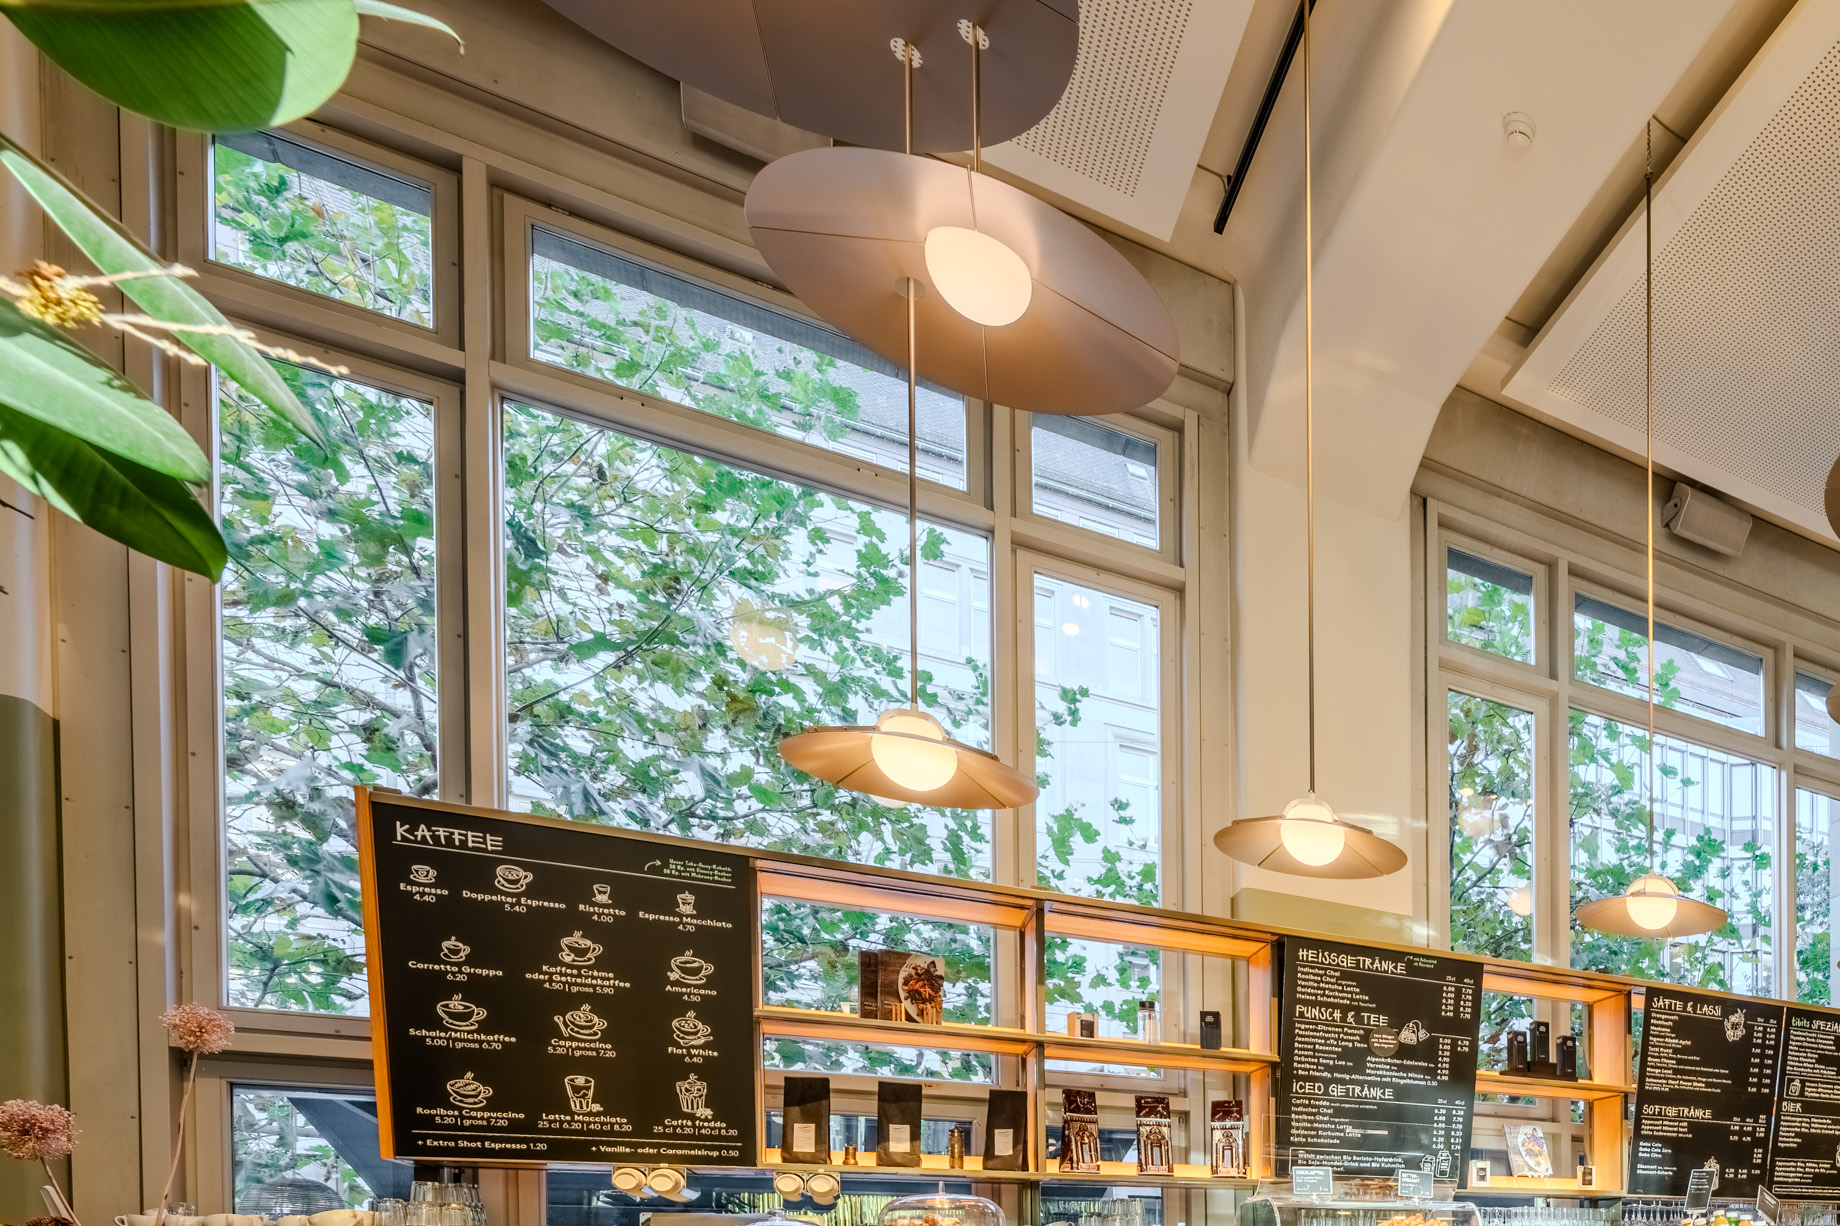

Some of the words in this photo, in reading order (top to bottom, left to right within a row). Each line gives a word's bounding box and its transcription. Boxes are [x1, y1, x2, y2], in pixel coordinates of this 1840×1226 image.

[396, 821, 504, 852] KAFFEE
[400, 883, 449, 895] Espresso
[413, 894, 436, 902] 4.40
[463, 890, 517, 903] Doppelter
[521, 897, 566, 909] Espresso
[505, 904, 526, 913] 5.40
[579, 904, 626, 916] Ristretto
[592, 914, 613, 923] 4.00
[639, 911, 680, 922] Espresso
[683, 917, 732, 928] Macchiato
[678, 924, 695, 932] 4.70
[1298, 948, 1406, 974] HEISSGETRÄNKE
[408, 961, 459, 972] Corretto
[462, 966, 503, 977] Grappa
[543, 965, 578, 975] Kaffee
[581, 969, 614, 978] Crème
[1298, 966, 1325, 974] Indischer
[447, 973, 467, 981] 6.20
[552, 974, 630, 988] Getreidekaffee
[543, 982, 563, 990] 4.50
[596, 986, 614, 994] 5.90
[665, 985, 717, 995] Americano
[1297, 980, 1342, 990] Vanille-Matcha
[1296, 986, 1324, 994] Goldener
[1325, 990, 1352, 998] Kurkuma
[1317, 995, 1350, 1004] Schokolade
[1652, 996, 1683, 1011] SÄFTE
[1686, 1002, 1694, 1014] &
[1696, 1003, 1722, 1016] LASSI
[1296, 1004, 1342, 1022] PUNSCH
[1346, 1011, 1356, 1025] &
[1360, 1012, 1388, 1026] TEE
[1792, 1016, 1810, 1027] tibits
[1295, 1022, 1342, 1032] Ingwer-Zitronen
[1344, 1027, 1364, 1035] Punsch
[1295, 1029, 1338, 1038] Passionsfrucht
[409, 1028, 516, 1042] Schale/Milchkaffee
[426, 1038, 447, 1046] 5.00
[482, 1042, 502, 1050] 6.70
[551, 1038, 612, 1050] Cappuccino
[1294, 1036, 1325, 1044] Jasmintee
[1338, 1040, 1352, 1048] Long
[1315, 1044, 1342, 1052] Rosentee
[548, 1046, 566, 1055] 5.20
[599, 1050, 616, 1058] 7.20
[668, 1047, 687, 1055] Flat
[690, 1049, 718, 1057] White
[1319, 1058, 1334, 1066] Song
[1292, 1079, 1324, 1094] ICED
[1328, 1084, 1394, 1100] GETRÄNKE
[1642, 1104, 1712, 1120] SOFTGETRÄNKE
[1782, 1101, 1802, 1112] BIER
[416, 1107, 459, 1115] Rooibos
[462, 1109, 525, 1119] Cappuccino
[543, 1113, 571, 1121] Latte
[574, 1115, 627, 1123] Macchiato
[435, 1116, 455, 1124] 5.20
[537, 1120, 549, 1128] 25
[427, 1139, 455, 1147] Extra
[458, 1140, 482, 1148] Shot
[485, 1141, 527, 1150] Espresso
[599, 1145, 635, 1153] Vanille-
[637, 1146, 658, 1154] oder
[660, 1148, 720, 1158] Caramelsirup
[721, 1150, 740, 1158] 0.50
